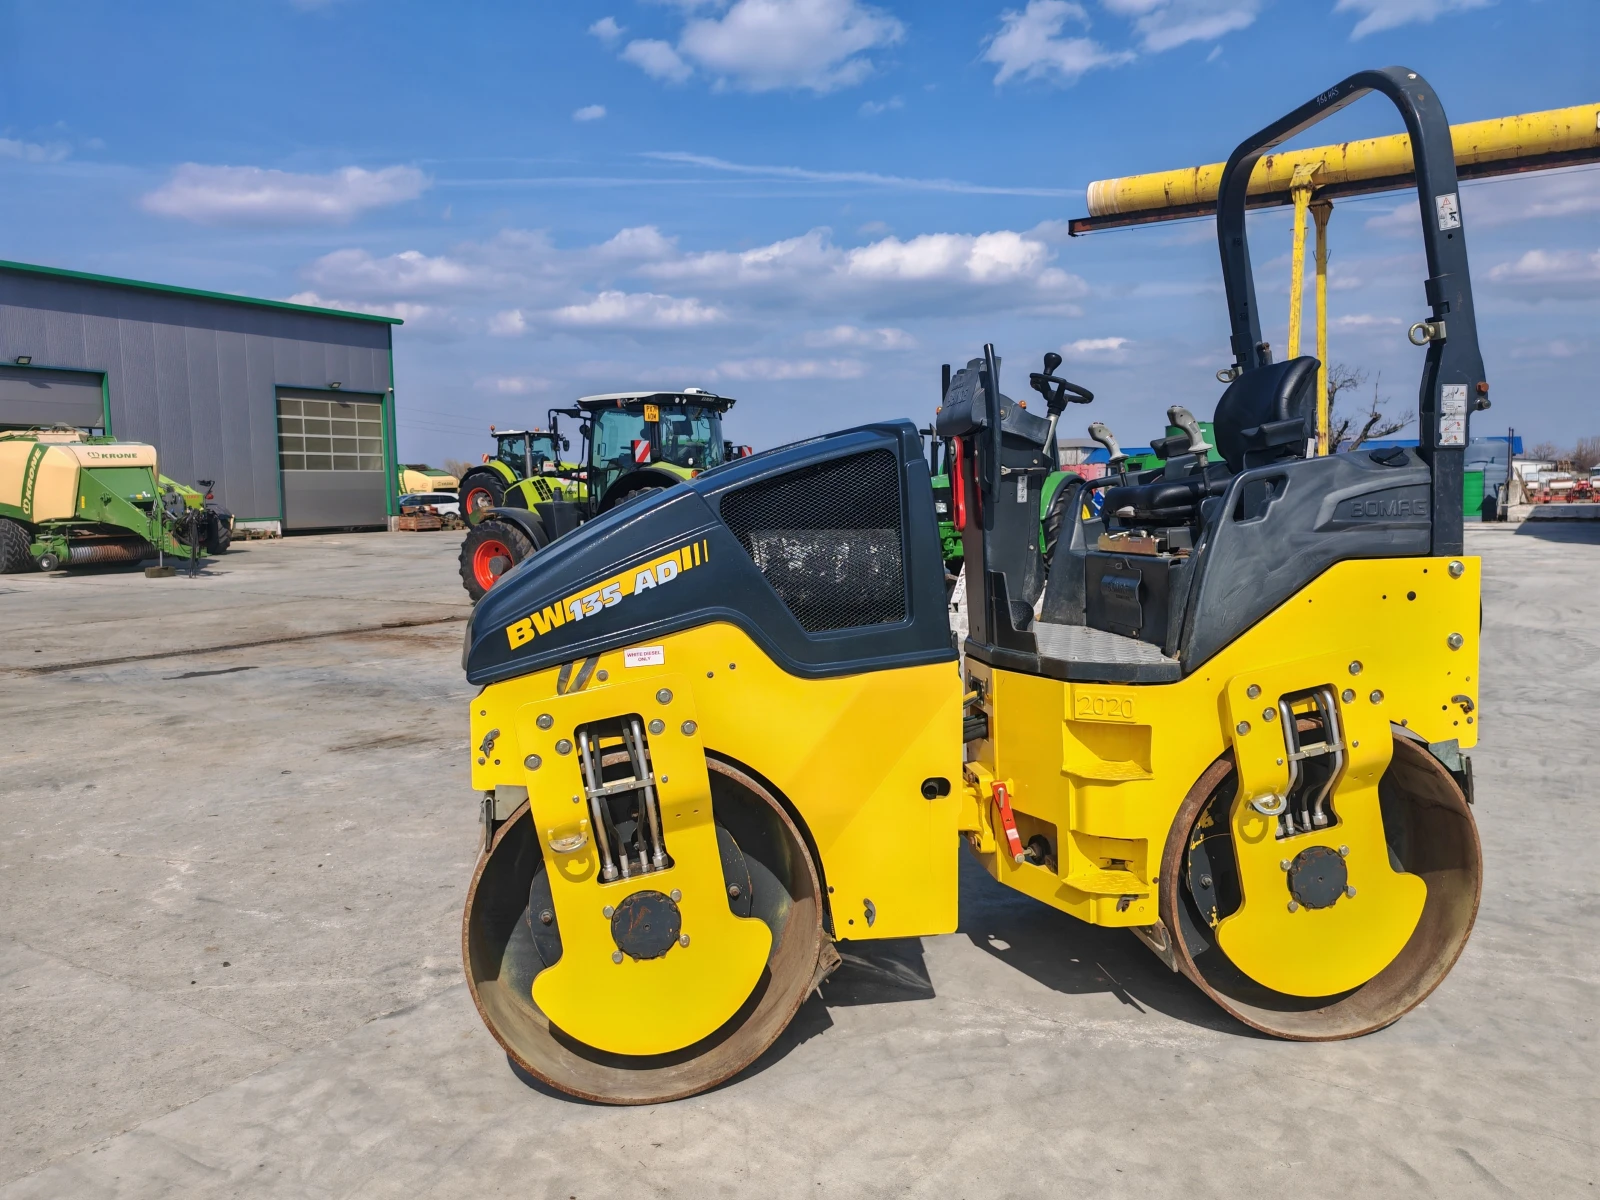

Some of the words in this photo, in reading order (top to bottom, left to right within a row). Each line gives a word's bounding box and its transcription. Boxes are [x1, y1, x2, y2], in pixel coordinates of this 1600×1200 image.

[25, 448, 41, 500] KRONE
[568, 581, 623, 622] 135
[633, 559, 679, 596] AD
[1077, 695, 1135, 719] 2020
